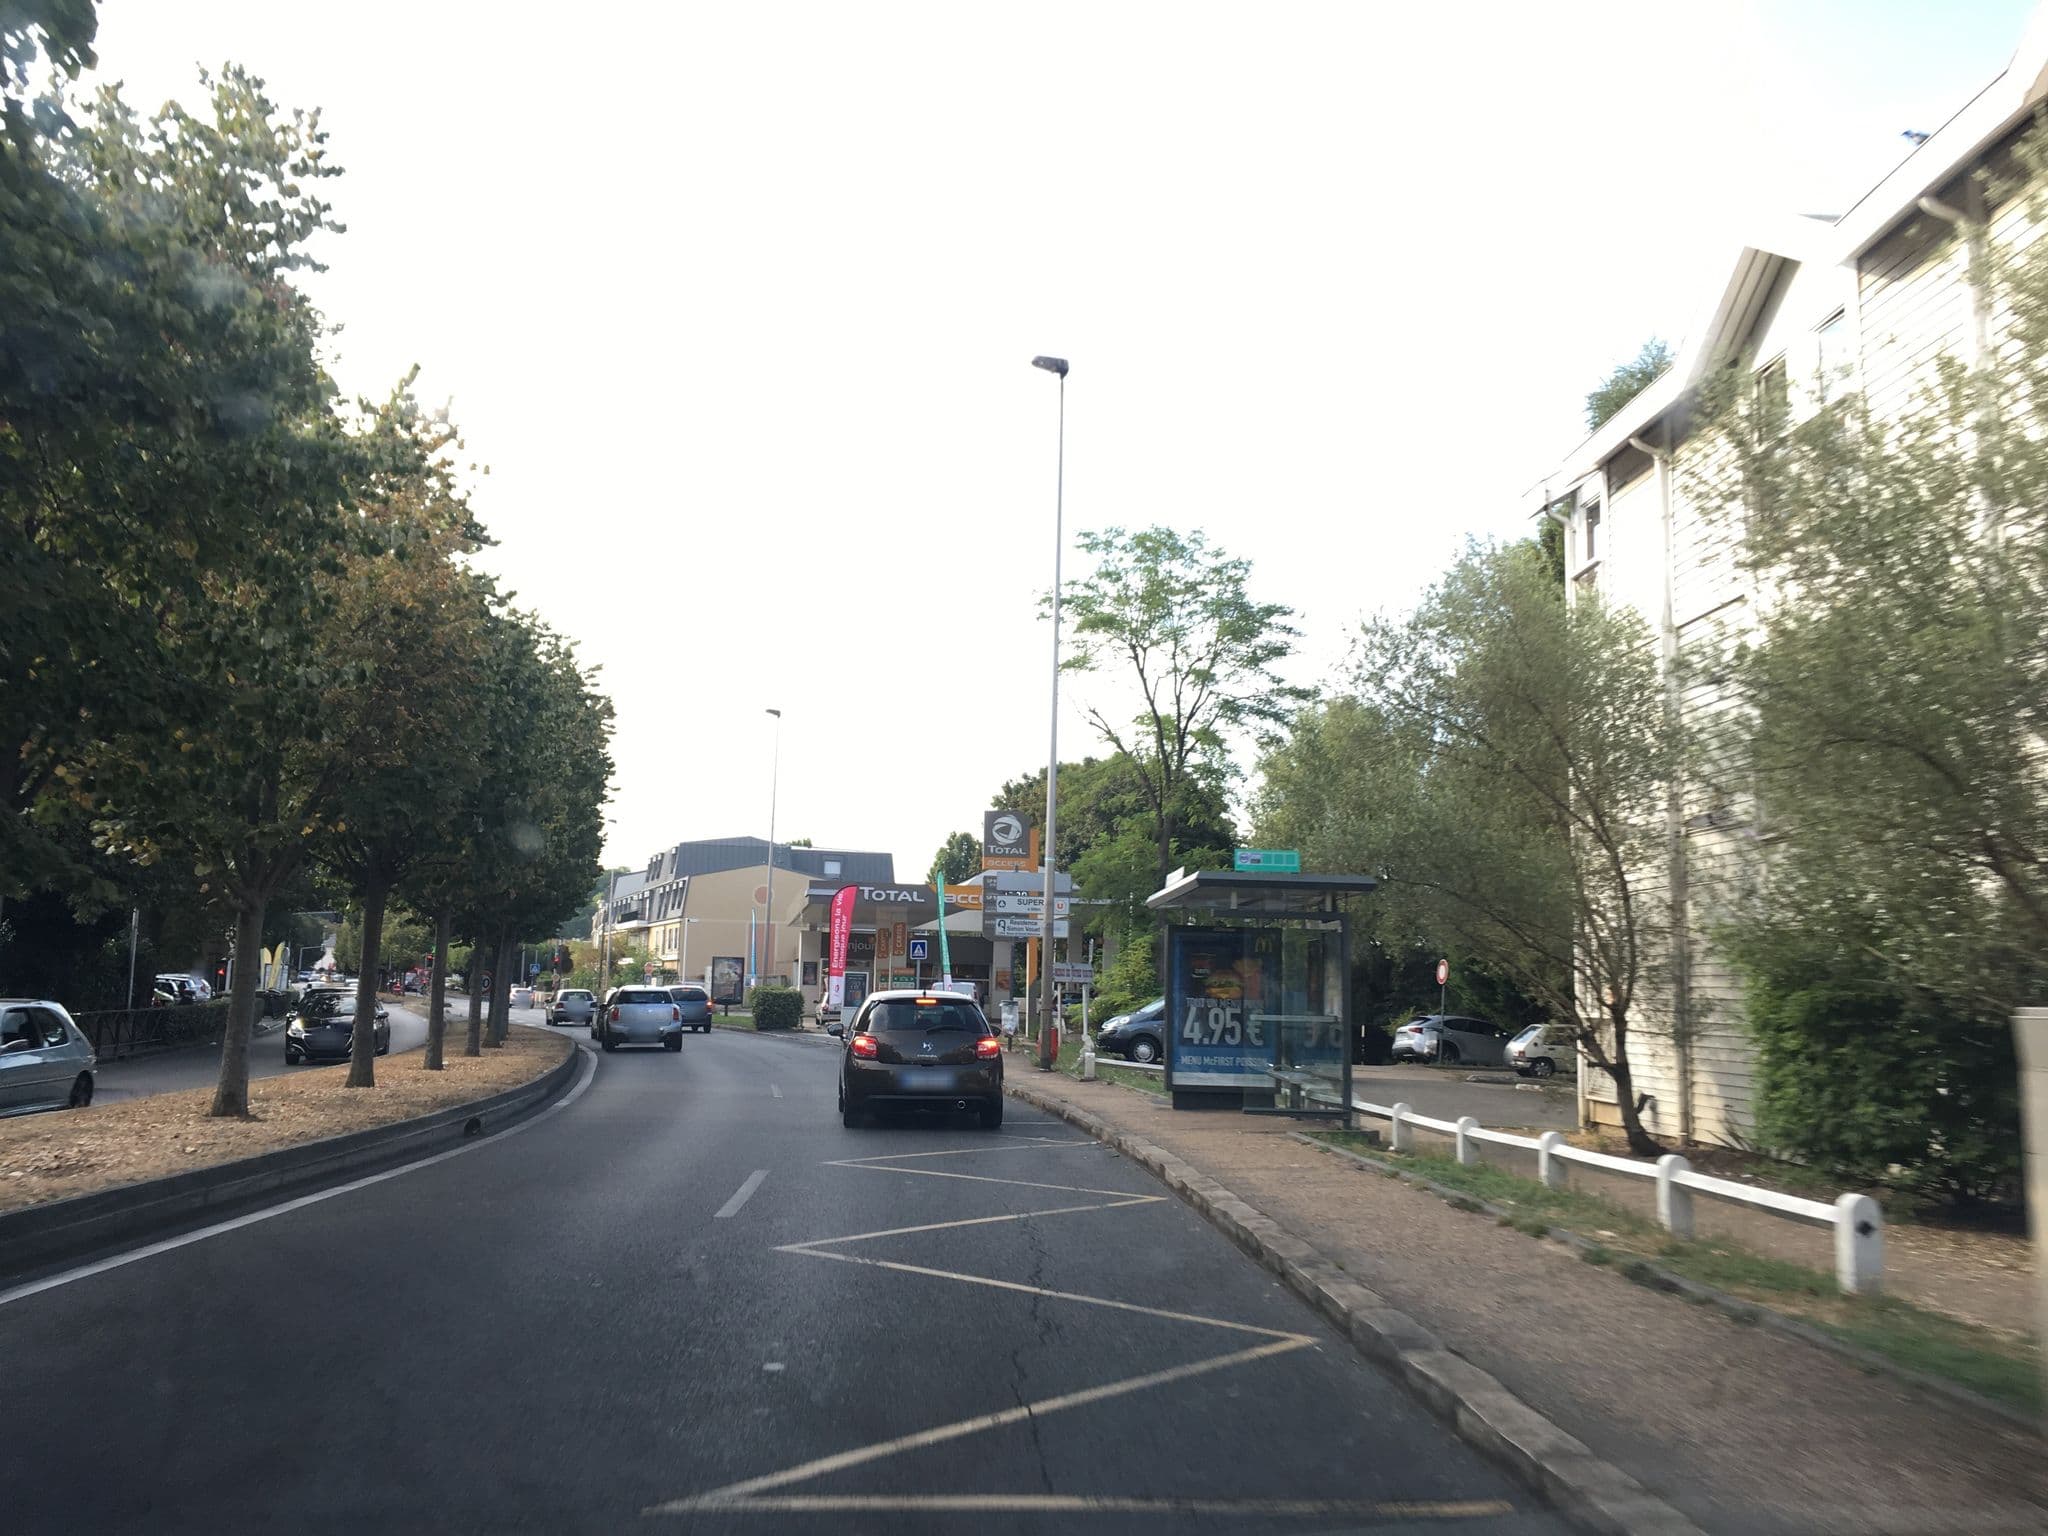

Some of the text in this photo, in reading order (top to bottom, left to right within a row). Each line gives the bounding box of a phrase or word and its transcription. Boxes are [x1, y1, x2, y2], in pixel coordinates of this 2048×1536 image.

[988, 845, 1027, 855] TOTAL
[859, 886, 925, 902] TOTAL
[1017, 898, 1045, 906] SUPER
